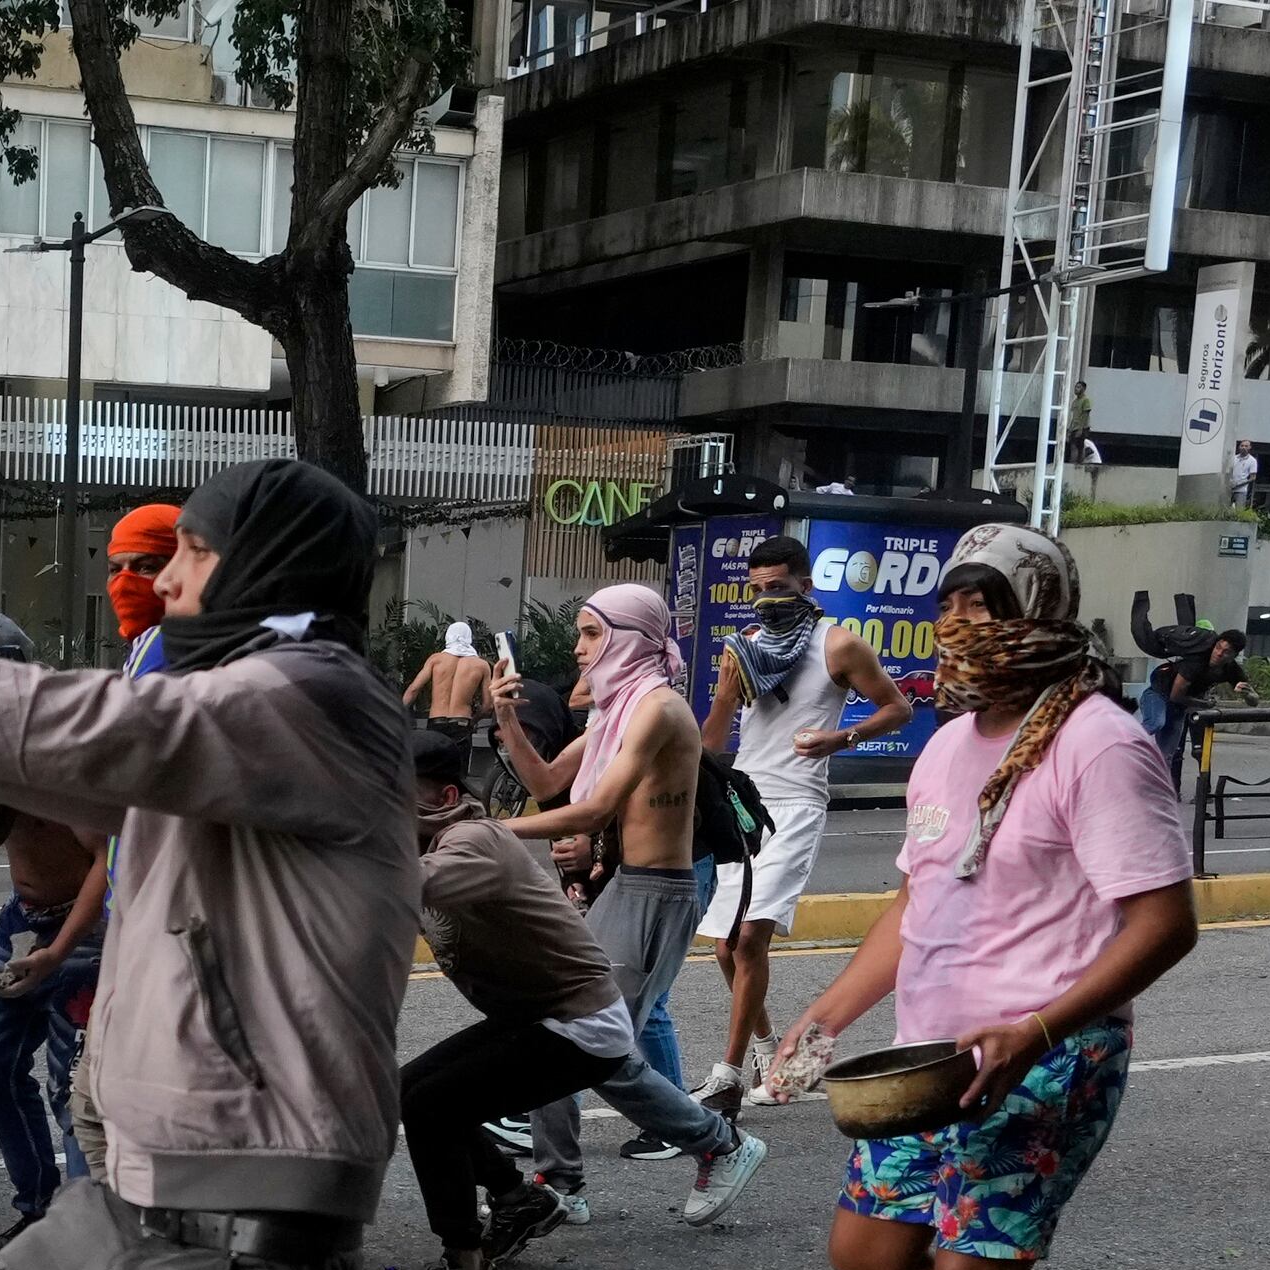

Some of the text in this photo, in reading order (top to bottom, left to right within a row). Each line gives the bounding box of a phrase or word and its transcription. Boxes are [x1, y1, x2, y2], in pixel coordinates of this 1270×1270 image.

[1198, 343, 1209, 390] Seguros
[741, 529, 766, 537] TRIPLE
[712, 535, 778, 558] GORD
[884, 536, 939, 553] TRIPLE
[721, 560, 736, 570] MÁS
[866, 604, 880, 613] Par
